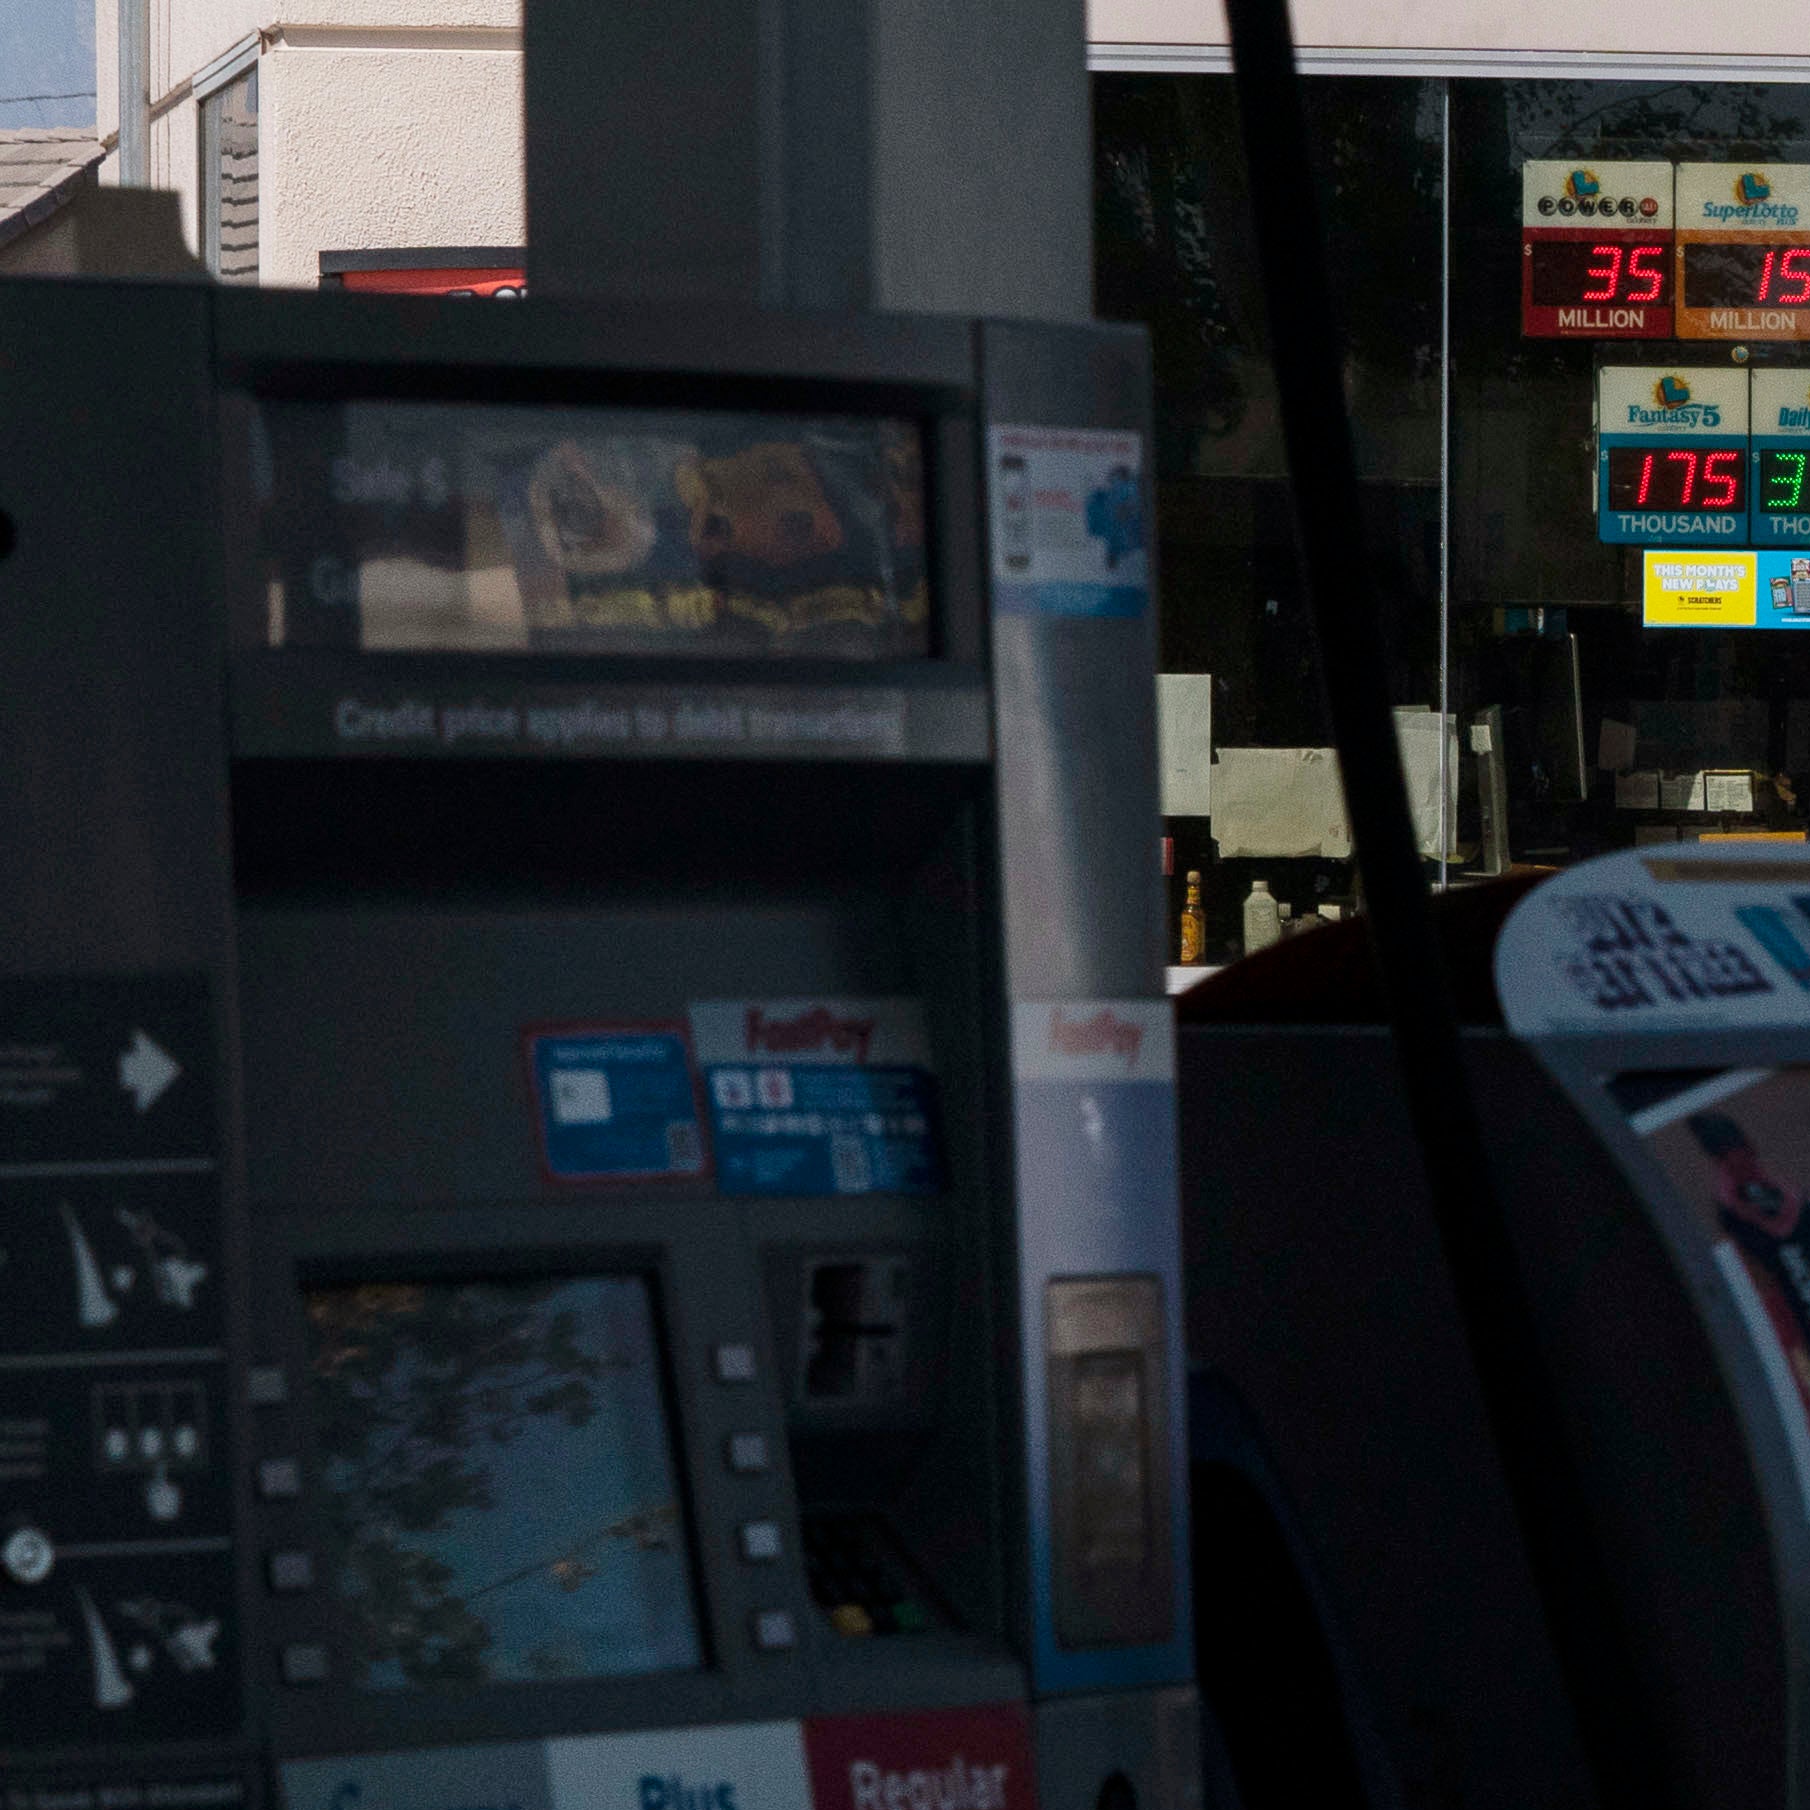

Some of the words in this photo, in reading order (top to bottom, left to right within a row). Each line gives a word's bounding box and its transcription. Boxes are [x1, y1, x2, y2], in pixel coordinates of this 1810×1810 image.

[1702, 200, 1799, 220] SuperLotto
[1583, 245, 1664, 302] 35
[1557, 309, 1644, 329] MILLION
[1709, 311, 1796, 331] MILLION
[1627, 403, 1700, 429] Fantasy
[1702, 404, 1721, 428] 5
[1636, 450, 1739, 508] 175
[1617, 514, 1738, 536] THOUSAND
[1653, 563, 1684, 577] THIS
[1685, 563, 1746, 578] MONTH'S
[1662, 578, 1694, 592] NEW
